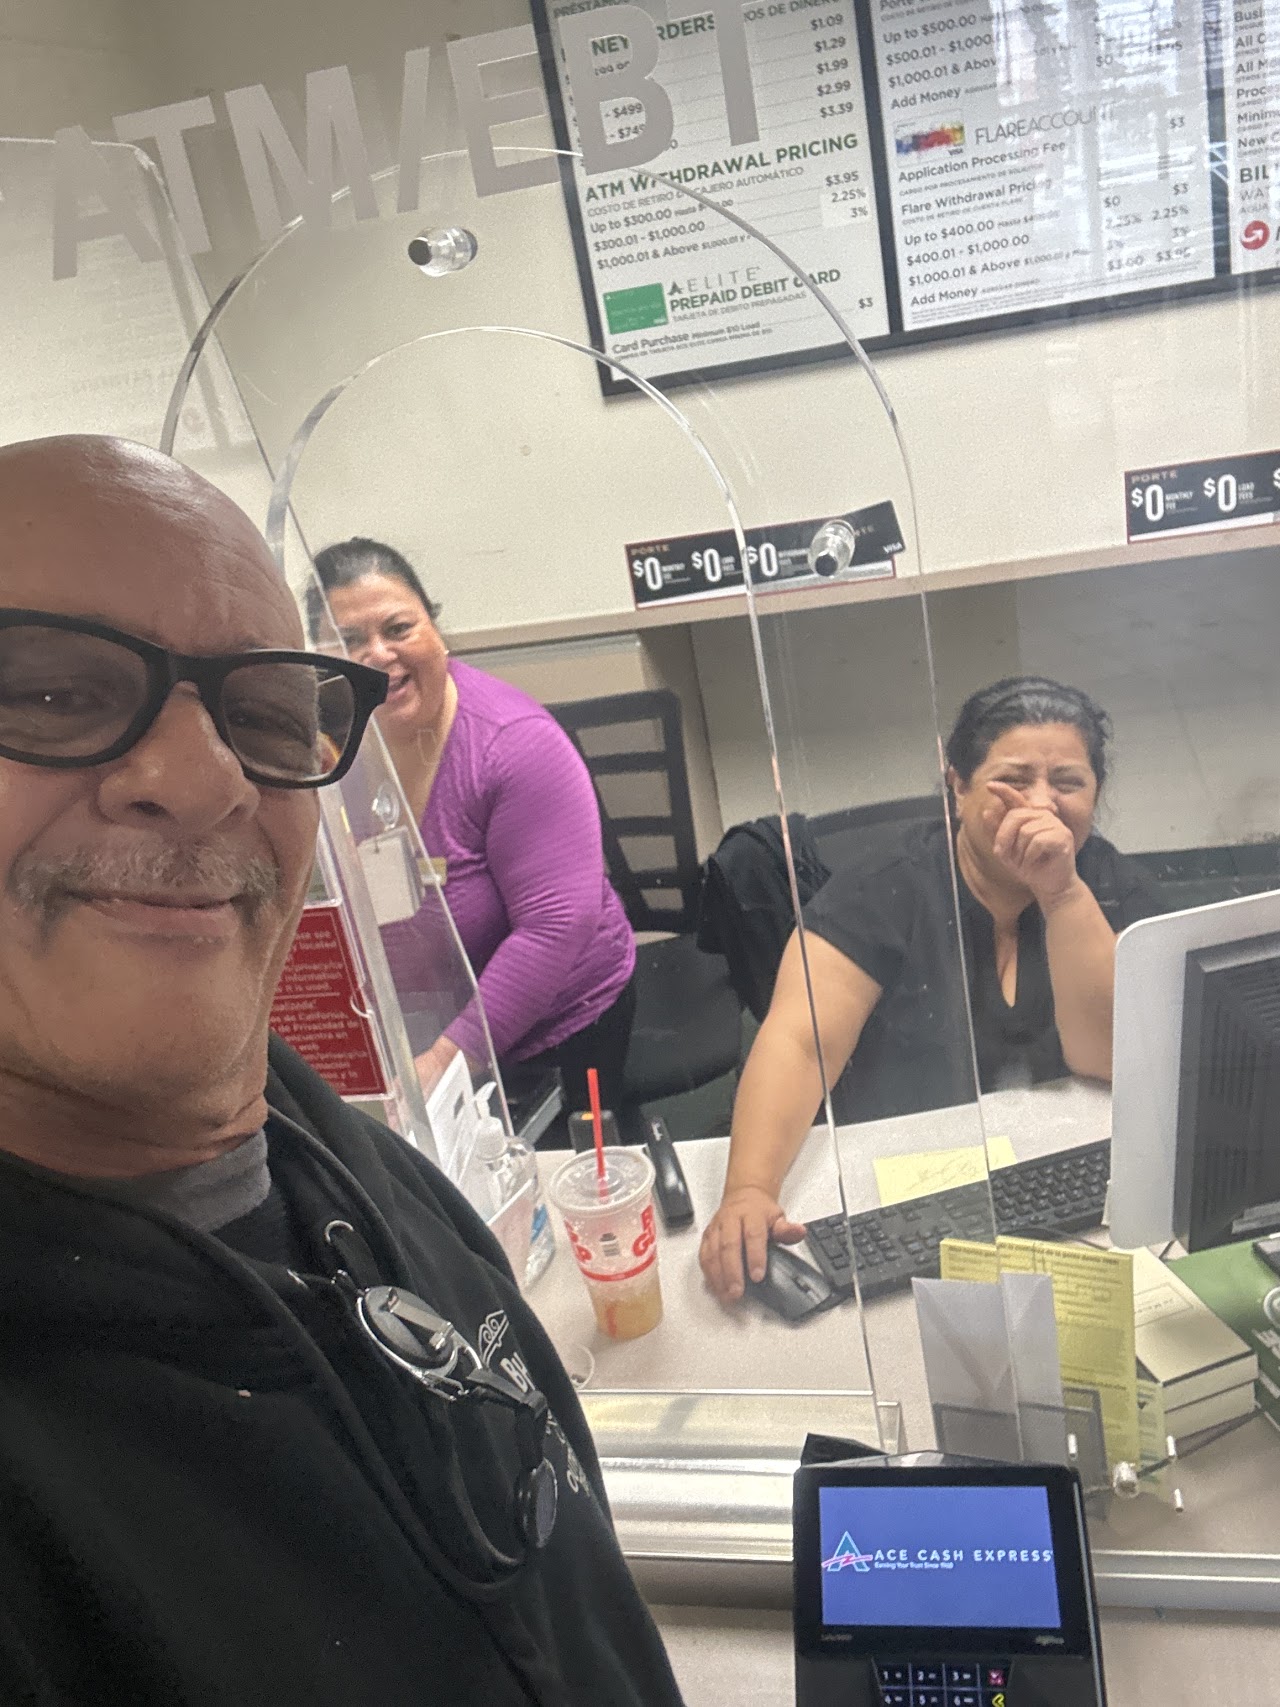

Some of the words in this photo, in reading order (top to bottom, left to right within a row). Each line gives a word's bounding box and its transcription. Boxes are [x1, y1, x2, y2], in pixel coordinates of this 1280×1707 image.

[657, 14, 715, 40] RDERS
[810, 14, 843, 31] $1.09
[883, 32, 901, 44] Up
[904, 28, 918, 39] to
[921, 14, 976, 36] $500.00
[814, 36, 846, 52] $1.29
[1235, 35, 1253, 48] All
[816, 58, 848, 75] $1.99
[886, 45, 936, 66] $500.01
[952, 63, 960, 74] &
[964, 57, 997, 72] Abov
[1236, 60, 1254, 74] All
[816, 80, 851, 97] $2.99
[891, 94, 917, 109] Add
[920, 87, 961, 103] Money
[819, 102, 853, 118] $3.39
[52, 0, 760, 280] ATM/EBT
[1238, 136, 1267, 149] New
[585, 180, 625, 203] ATM
[630, 152, 771, 193] WHDRAWAL
[776, 133, 859, 164] PRICING
[899, 160, 968, 182] Application
[971, 146, 1039, 168] Processing
[1042, 140, 1066, 153] Fee
[825, 171, 859, 187] $3.95
[831, 188, 867, 203] 2.25%
[901, 201, 932, 215] Flare
[935, 185, 1006, 208] Withdrawal
[590, 222, 607, 234] Up
[609, 218, 621, 230] to
[623, 208, 672, 227] $300.00
[850, 205, 869, 218] 3%
[593, 234, 639, 252] $300.01
[648, 220, 705, 243] $1,000.00
[904, 234, 922, 247] Up
[924, 231, 938, 242] to
[941, 219, 995, 239] $400.00
[596, 251, 649, 271] $1,000.01
[651, 249, 660, 259] &
[662, 242, 699, 258] Above
[906, 247, 957, 267] $400.01
[967, 233, 1030, 256] $1,000.00
[687, 266, 757, 292] ELITE
[908, 267, 966, 287] $1,000.01
[968, 265, 977, 275] &
[980, 257, 1021, 274] Above
[670, 289, 738, 312] PREPAID
[741, 277, 789, 299] DEBIT
[858, 297, 873, 309] $3
[910, 294, 936, 307] Add
[938, 286, 979, 302] Money
[612, 340, 638, 354] Card
[640, 333, 689, 348] Purchase
[1131, 470, 1179, 485] PORTE
[1131, 484, 1165, 522] $0
[1203, 474, 1236, 512] $0
[691, 548, 722, 583] $0
[747, 542, 779, 577] $0
[632, 557, 663, 591] $0
[874, 1549, 908, 1561] ACE
[917, 1549, 964, 1561] CASH
[973, 1549, 1052, 1562] EXPRESS
